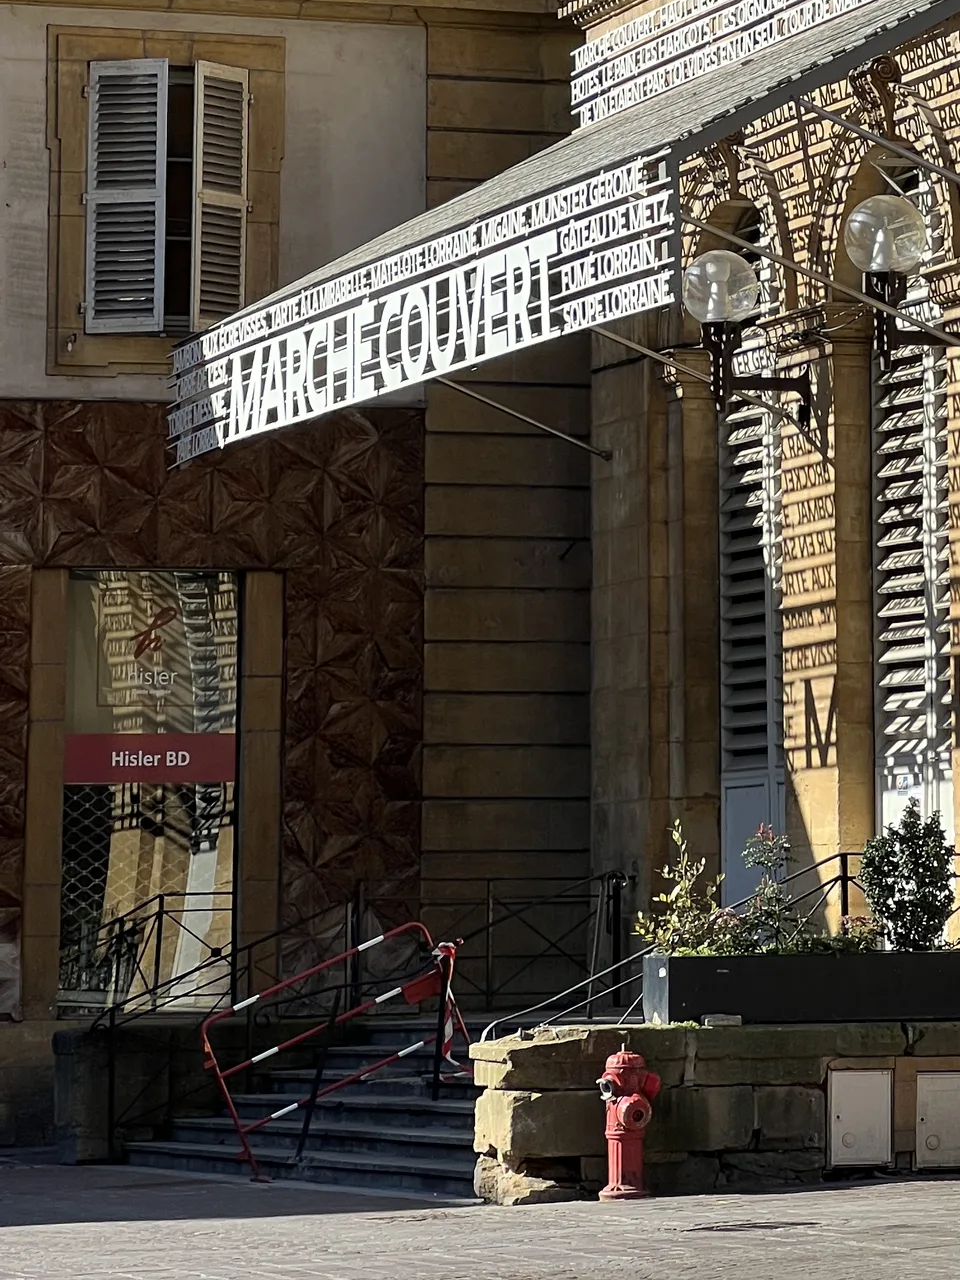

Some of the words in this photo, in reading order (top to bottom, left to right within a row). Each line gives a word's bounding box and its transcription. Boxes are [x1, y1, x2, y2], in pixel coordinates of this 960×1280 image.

[602, 61, 613, 87] LE
[640, 41, 657, 68] LES
[716, 4, 736, 34] LES
[580, 102, 592, 126] DE
[559, 206, 606, 258] GÂTEAU
[608, 203, 627, 240] DE
[629, 186, 673, 239] METZ,
[202, 330, 218, 359] AUX
[271, 297, 298, 330] TARTE
[308, 288, 319, 314] LA
[320, 266, 369, 312] MIRABELLE,
[371, 244, 424, 291] MATELOTE
[425, 222, 479, 274] LORRAINE,
[481, 203, 527, 252] MIGAINE,
[531, 180, 587, 230] MUNSTER
[561, 249, 597, 296] FUMÉ
[597, 231, 658, 289] LORRAIN,
[228, 295, 374, 442] MARCHÉ
[378, 228, 559, 394] COUVERT
[563, 291, 605, 334] SOUPE
[127, 667, 178, 686] hisler
[111, 750, 161, 767] Hisler
[166, 750, 190, 767] BD
